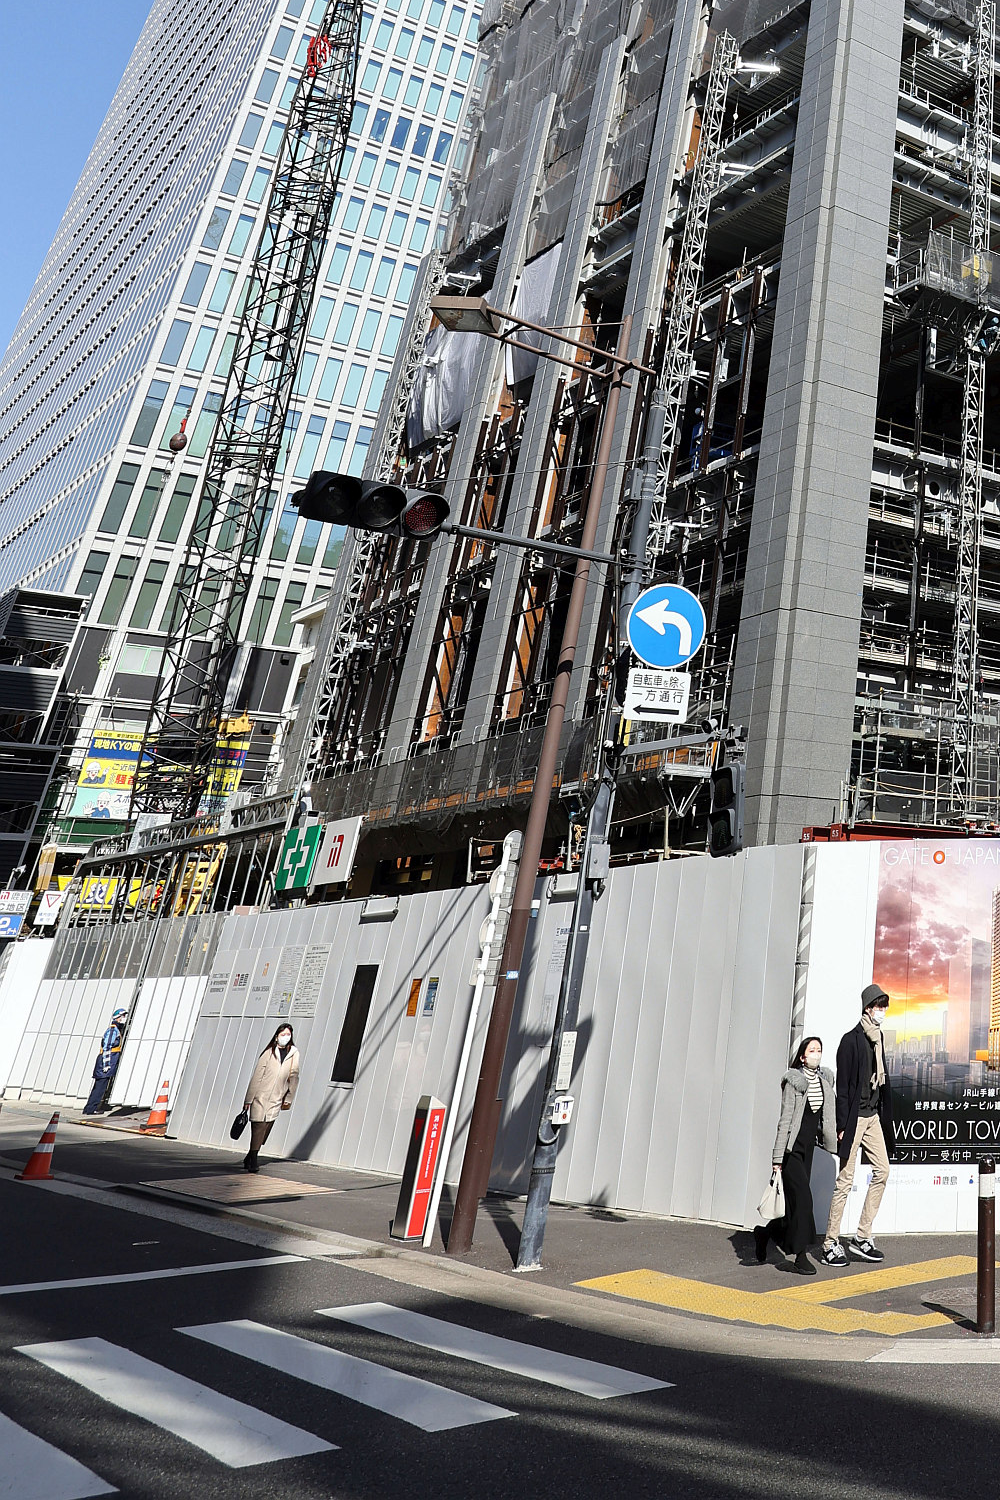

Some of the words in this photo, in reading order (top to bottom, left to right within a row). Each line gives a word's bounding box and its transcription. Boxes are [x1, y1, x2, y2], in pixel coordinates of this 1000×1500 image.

[635, 674, 685, 689] 自転車を除く
[632, 689, 684, 704] 一方通行
[884, 847, 929, 866] GATE
[933, 847, 952, 866] OF
[892, 1119, 958, 1140] WORLD
[889, 1150, 972, 1162] エントリー受付中
